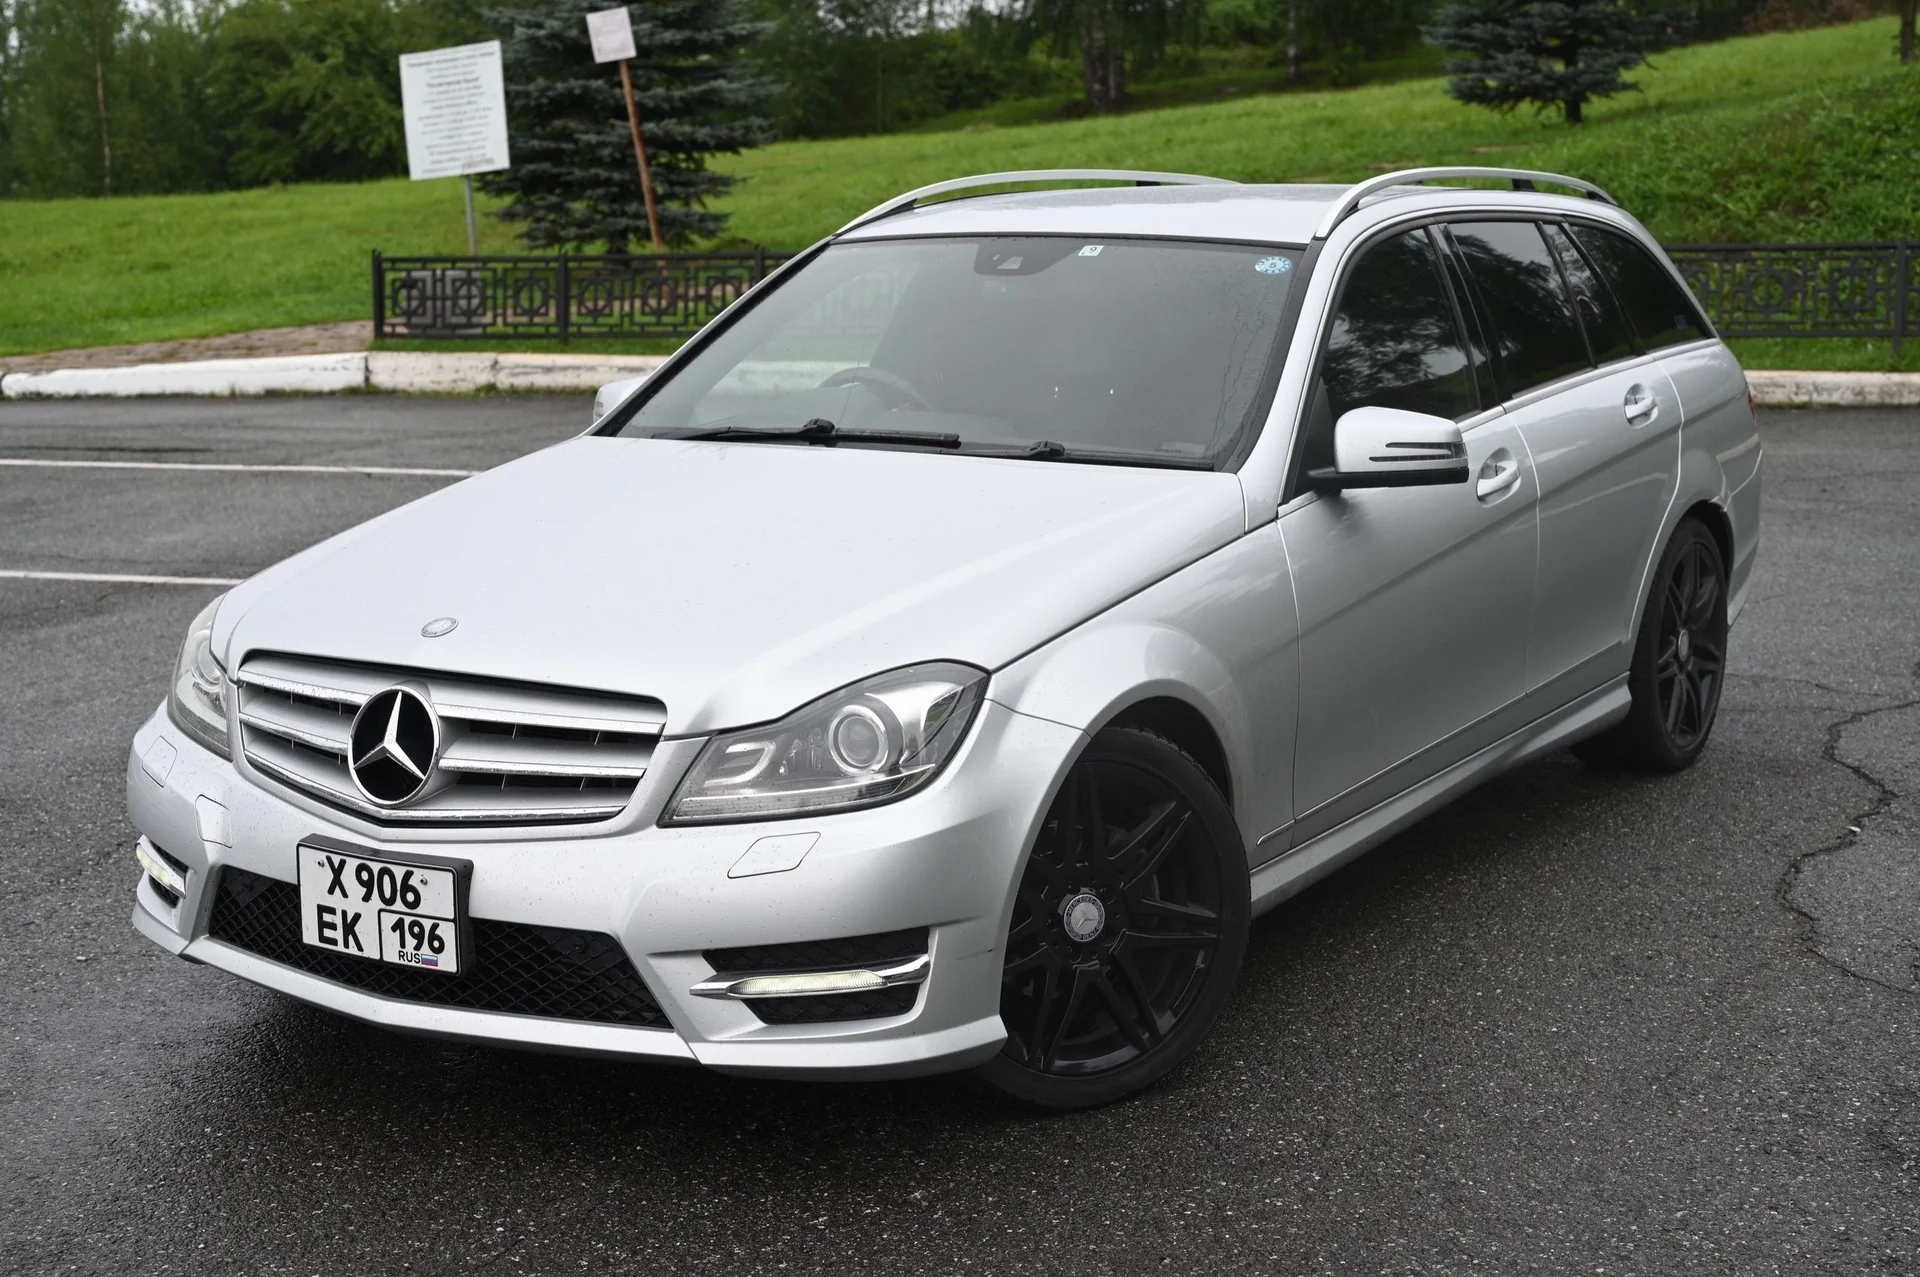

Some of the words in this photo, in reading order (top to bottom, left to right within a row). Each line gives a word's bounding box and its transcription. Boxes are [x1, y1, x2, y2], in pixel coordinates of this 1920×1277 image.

[325, 855, 349, 899] X
[355, 862, 422, 910] 906
[317, 903, 364, 953] EK
[390, 917, 446, 954] 196
[398, 950, 421, 964] RUS
